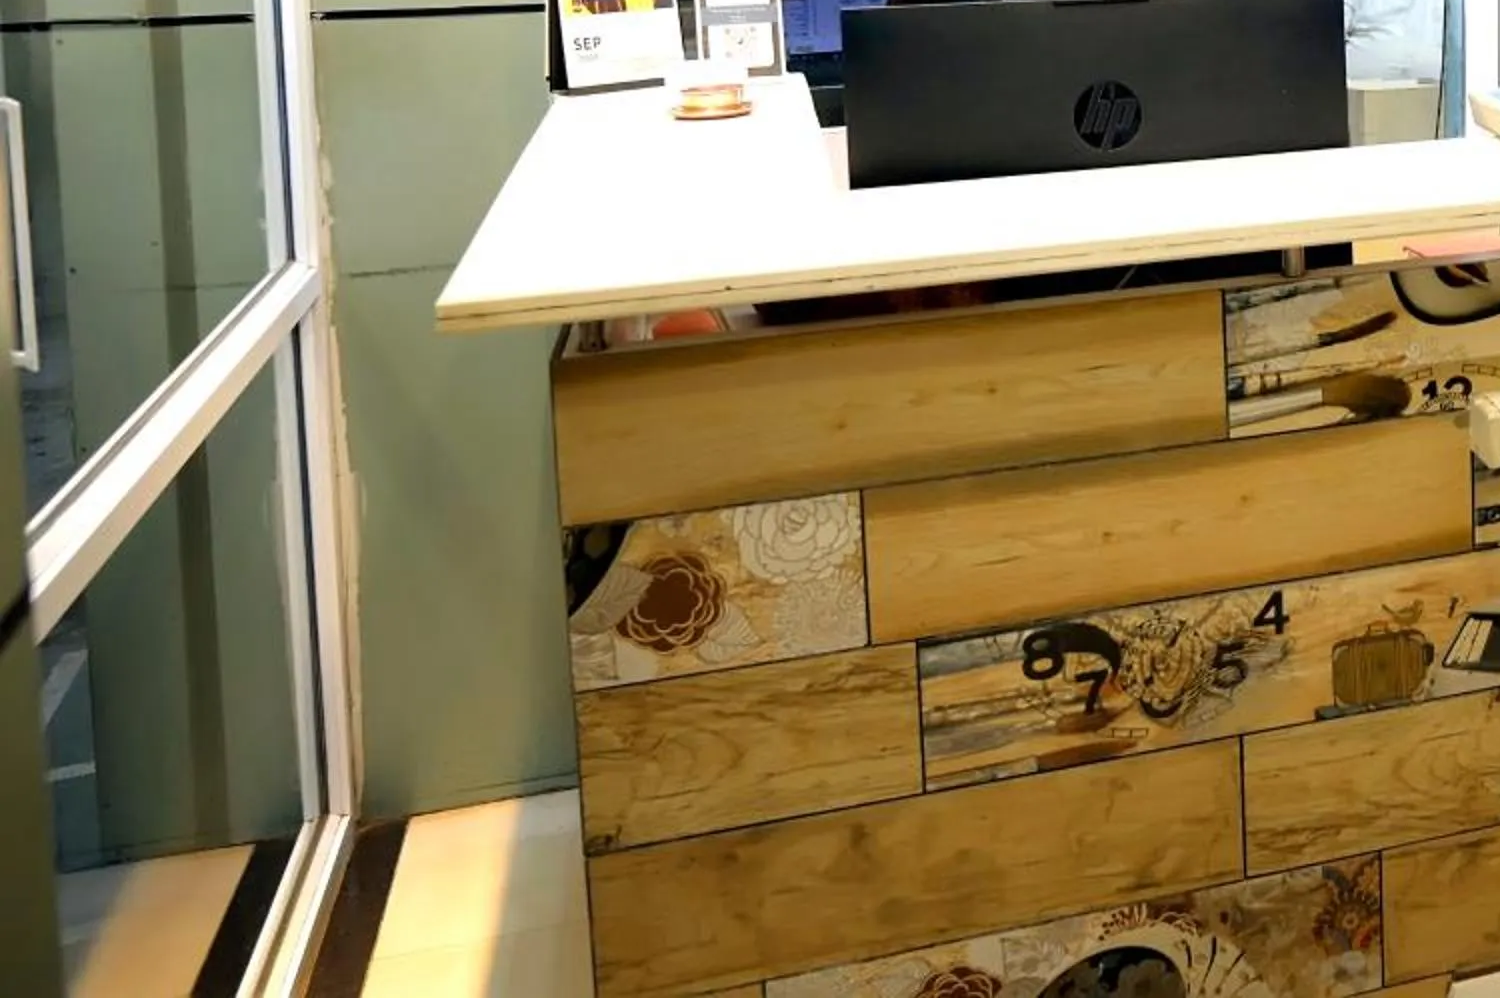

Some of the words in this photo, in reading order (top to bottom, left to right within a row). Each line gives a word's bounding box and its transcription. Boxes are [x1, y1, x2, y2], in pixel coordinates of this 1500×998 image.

[573, 36, 602, 51] SEP
[1079, 81, 1139, 149] hp
[1252, 589, 1291, 635] 4
[1021, 628, 1065, 681] 8
[1073, 668, 1109, 715] 7
